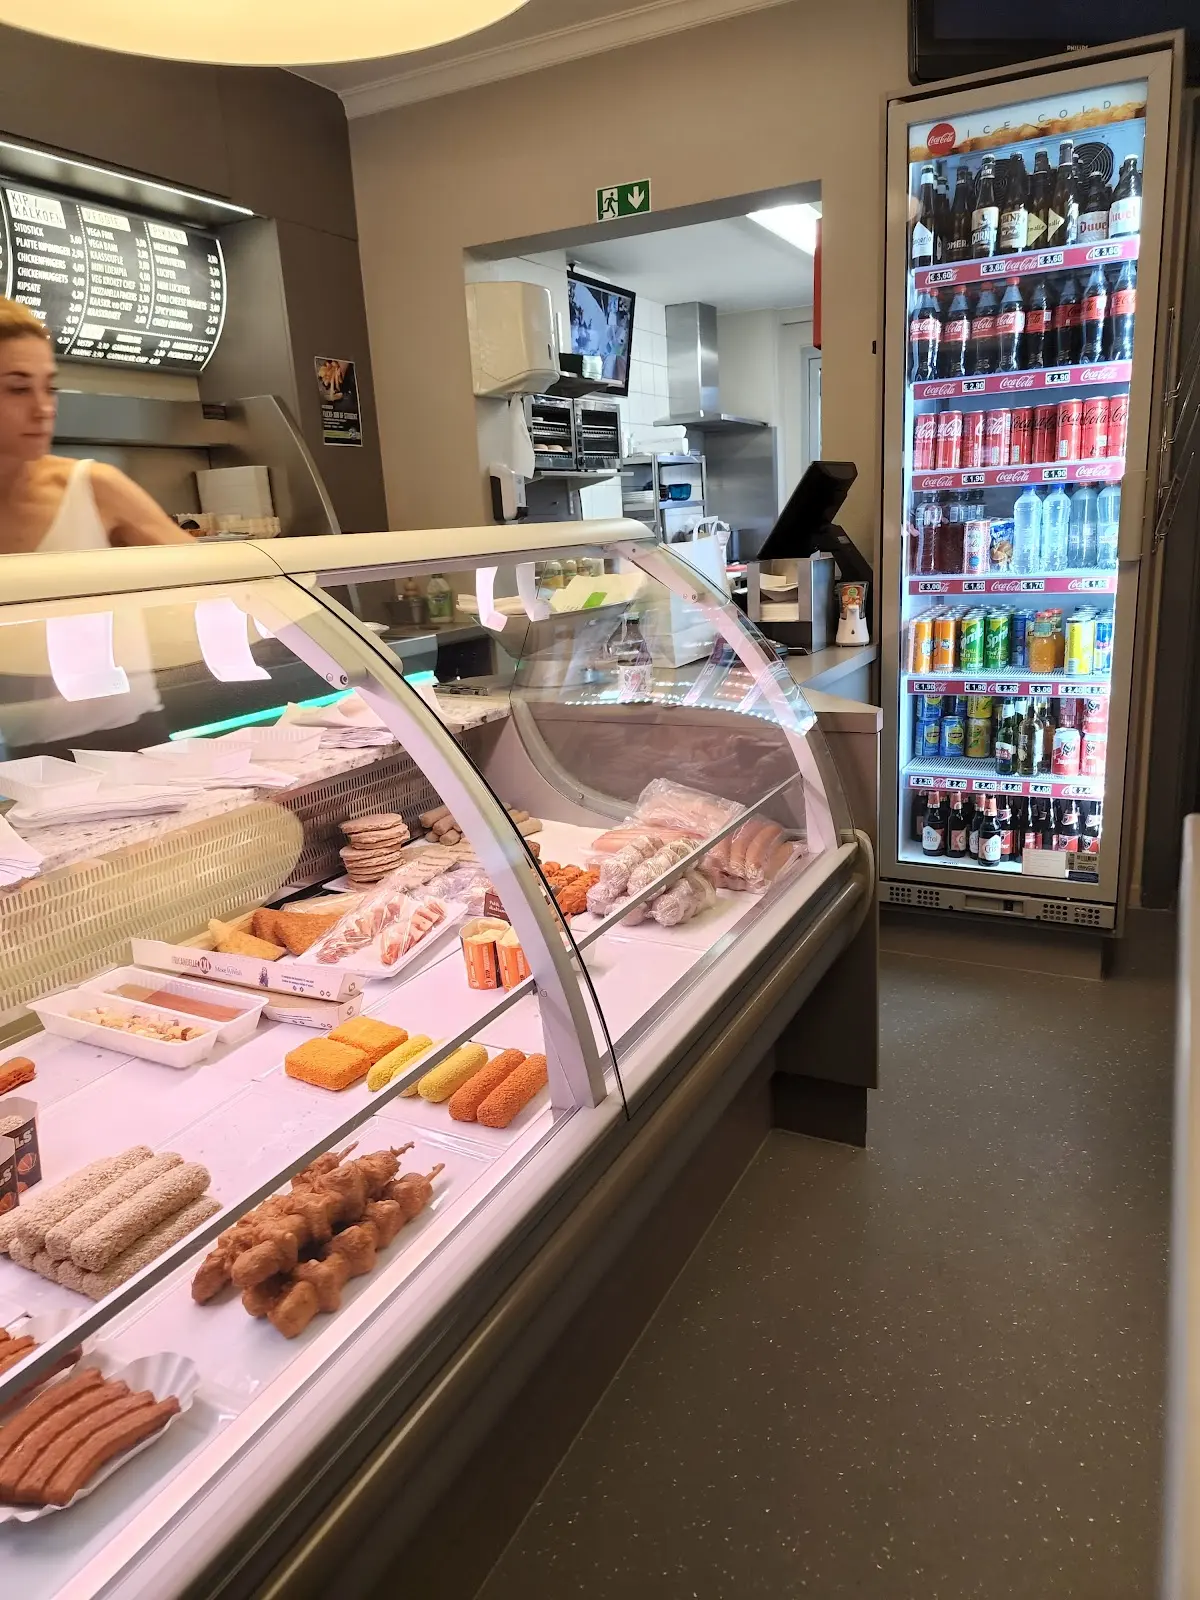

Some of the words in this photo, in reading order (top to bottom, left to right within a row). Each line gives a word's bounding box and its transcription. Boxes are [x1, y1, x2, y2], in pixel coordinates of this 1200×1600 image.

[967, 119, 1011, 139] ICE
[1037, 100, 1112, 123] COLD
[14, 204, 63, 224] KALKOEN
[14, 222, 44, 237] SITOSTICK
[16, 237, 38, 250] PLATTE
[17, 281, 41, 293] KIPSATE
